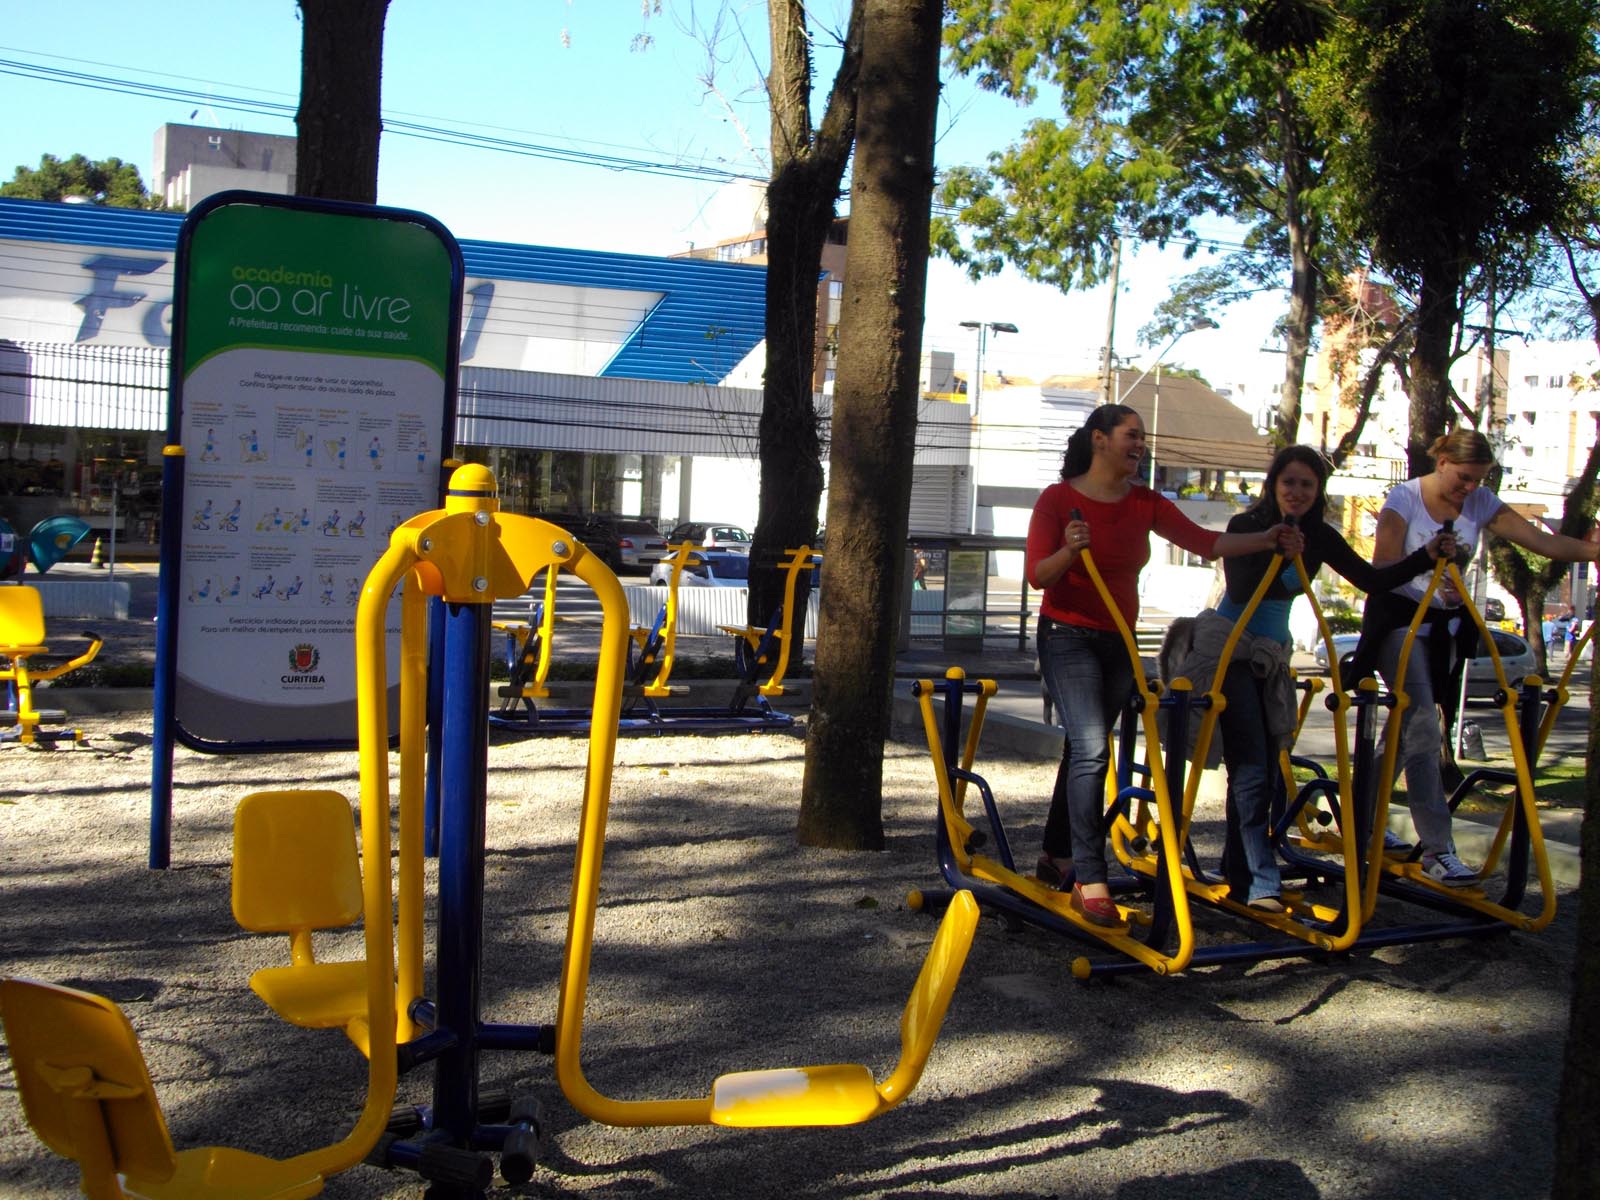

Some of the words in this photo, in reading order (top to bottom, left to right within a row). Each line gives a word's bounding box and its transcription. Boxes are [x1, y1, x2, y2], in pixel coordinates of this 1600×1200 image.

[231, 265, 333, 288] academia
[230, 283, 281, 312] ao
[292, 289, 333, 317] ar
[343, 283, 411, 324] livre
[228, 317, 236, 326] A
[236, 317, 279, 331] Prefeitura
[280, 321, 327, 335] recomenda:
[330, 325, 353, 337] cuide
[355, 326, 366, 337] da
[367, 329, 383, 338] sua
[239, 379, 266, 389] Confira
[267, 382, 297, 391] algumas
[348, 387, 363, 395] lado
[265, 617, 299, 625] indicados
[345, 617, 354, 625] de
[280, 675, 326, 683] CURITIBA
